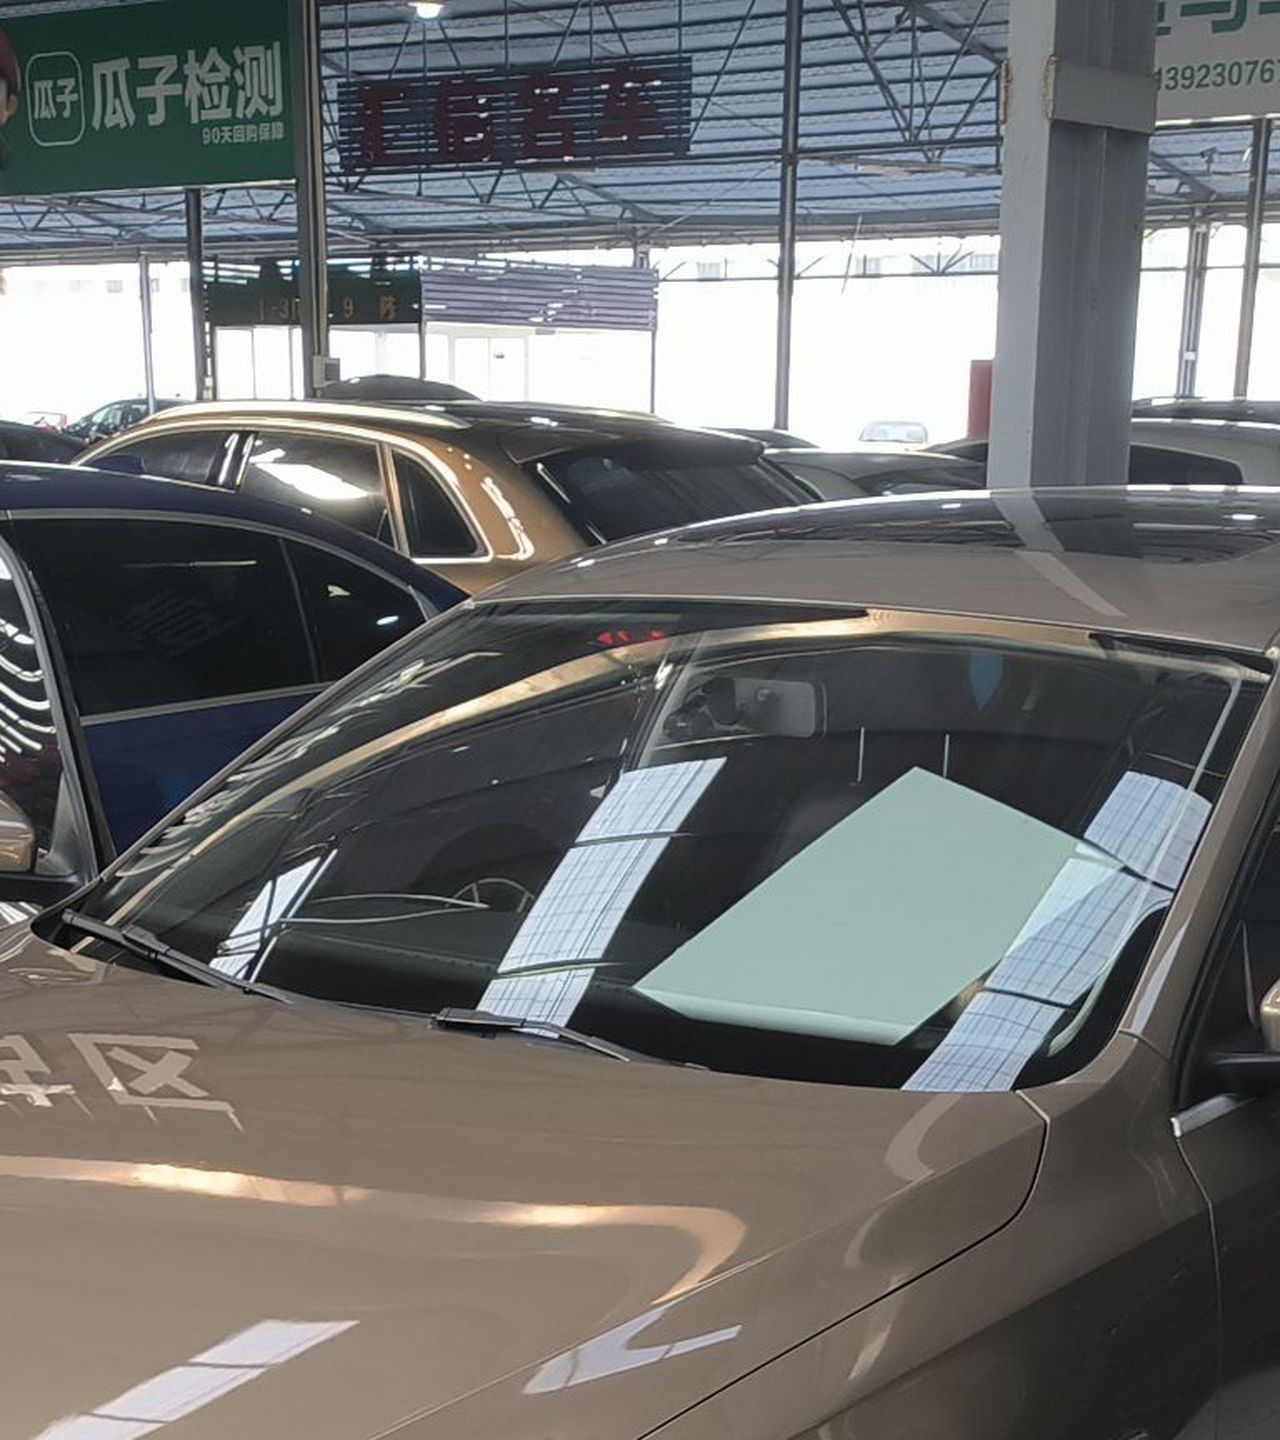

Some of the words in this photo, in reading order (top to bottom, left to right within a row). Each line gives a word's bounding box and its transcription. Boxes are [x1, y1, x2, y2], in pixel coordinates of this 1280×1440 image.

[33, 78, 79, 119] 瓜子
[91, 41, 284, 131] 瓜子检测
[201, 121, 285, 145] 90天回购保障
